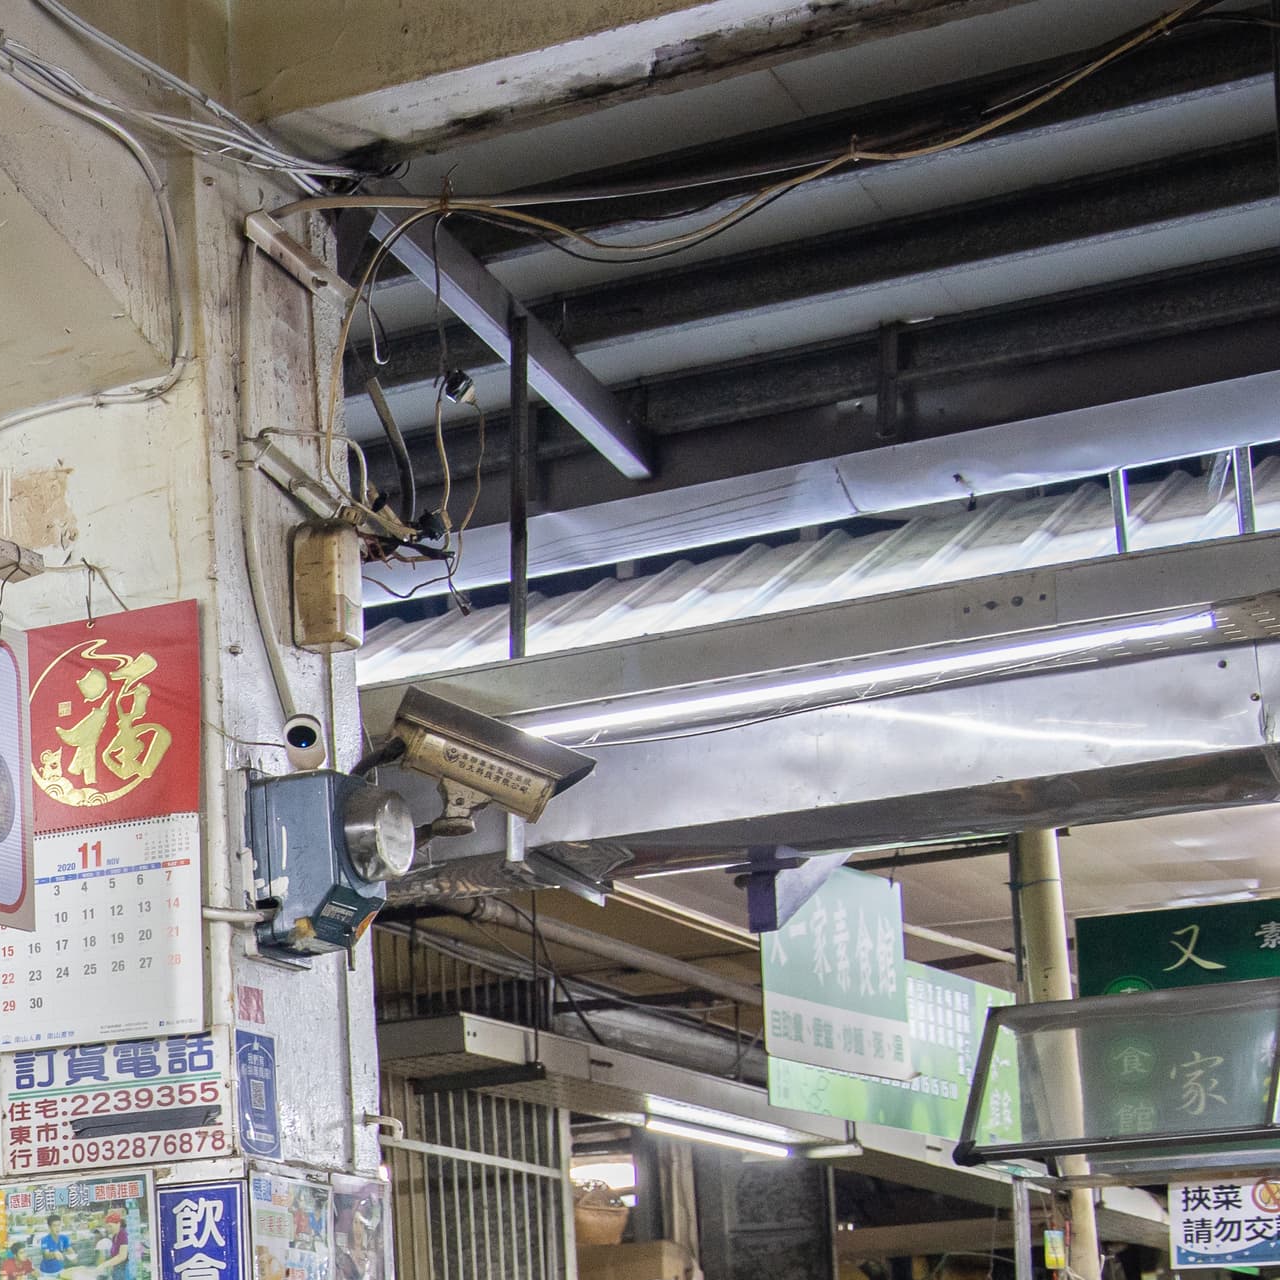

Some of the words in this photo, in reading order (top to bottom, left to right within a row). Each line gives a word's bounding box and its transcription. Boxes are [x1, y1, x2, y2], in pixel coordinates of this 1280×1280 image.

[56, 652, 172, 785] 福
[57, 862, 76, 872] 2020
[78, 841, 102, 869] 11
[53, 885, 61, 896] 3
[81, 882, 88, 892] 4
[109, 878, 116, 889] 5
[136, 874, 144, 885] 6
[165, 871, 172, 881] 7
[55, 911, 68, 923] 10
[82, 908, 95, 920] 11
[110, 904, 124, 916] 12
[138, 901, 151, 912] 13
[166, 897, 180, 908] 14
[1, 945, 14, 957] 15
[28, 943, 41, 954] 16
[56, 939, 68, 950] 17
[83, 936, 96, 948] 18
[111, 932, 124, 944] 19
[138, 929, 152, 941] 20
[167, 926, 180, 937] 21
[1, 973, 15, 984] 22
[29, 970, 42, 981] 23
[56, 967, 69, 978] 24
[83, 964, 97, 975] 25
[112, 960, 125, 972] 26
[139, 957, 152, 969] 27
[167, 954, 181, 966] 28
[2, 1000, 16, 1012] 29
[30, 997, 43, 1009] 30
[13, 1037, 214, 1090] 訂貨電話
[1181, 1185, 1242, 1212] 挾菜
[1183, 1217, 1280, 1245] 請勿交
